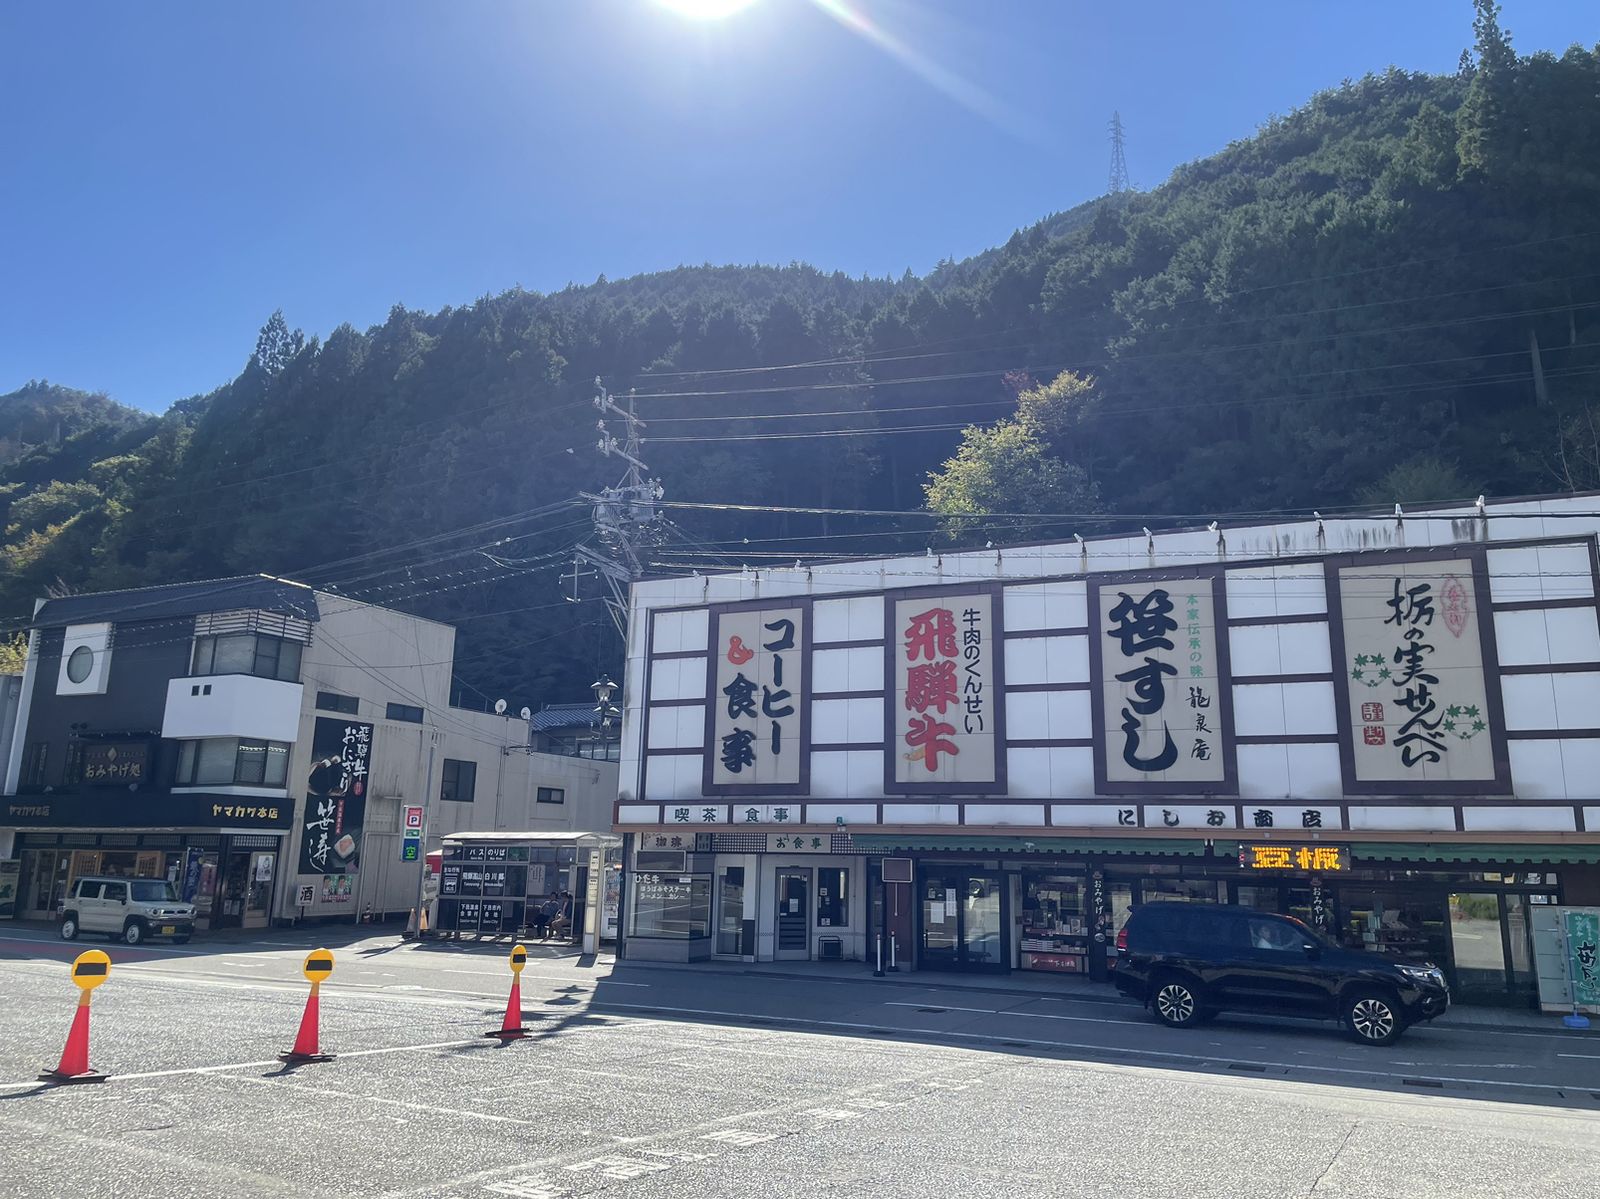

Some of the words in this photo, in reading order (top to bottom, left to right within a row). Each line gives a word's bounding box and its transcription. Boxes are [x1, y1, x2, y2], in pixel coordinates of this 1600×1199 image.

[1186, 593, 1205, 678] 本家伝承の味
[961, 608, 984, 735] 牛肉のくんせい
[1106, 587, 1180, 773] 笹すし
[1384, 577, 1450, 769] 栃の実せんべい
[761, 618, 796, 755] コーヒー
[904, 607, 960, 773] 飛騨牛
[1184, 686, 1213, 762] 龍泉庵
[85, 760, 142, 778] おみやげ処
[338, 727, 357, 793] おにぎり
[212, 804, 279, 819] ヤマカワ本店
[411, 816, 418, 824] P
[674, 807, 717, 823] 喫茶
[745, 807, 790, 823] 食事
[1118, 807, 1321, 829] にしお商店
[405, 845, 417, 859] 空
[469, 848, 506, 857] バスのりば
[775, 834, 823, 850] お食事
[635, 874, 660, 885] ひだ牛
[300, 886, 313, 902] 酒
[1094, 880, 1104, 915] おみやげ
[1312, 887, 1325, 925] おみやげ
